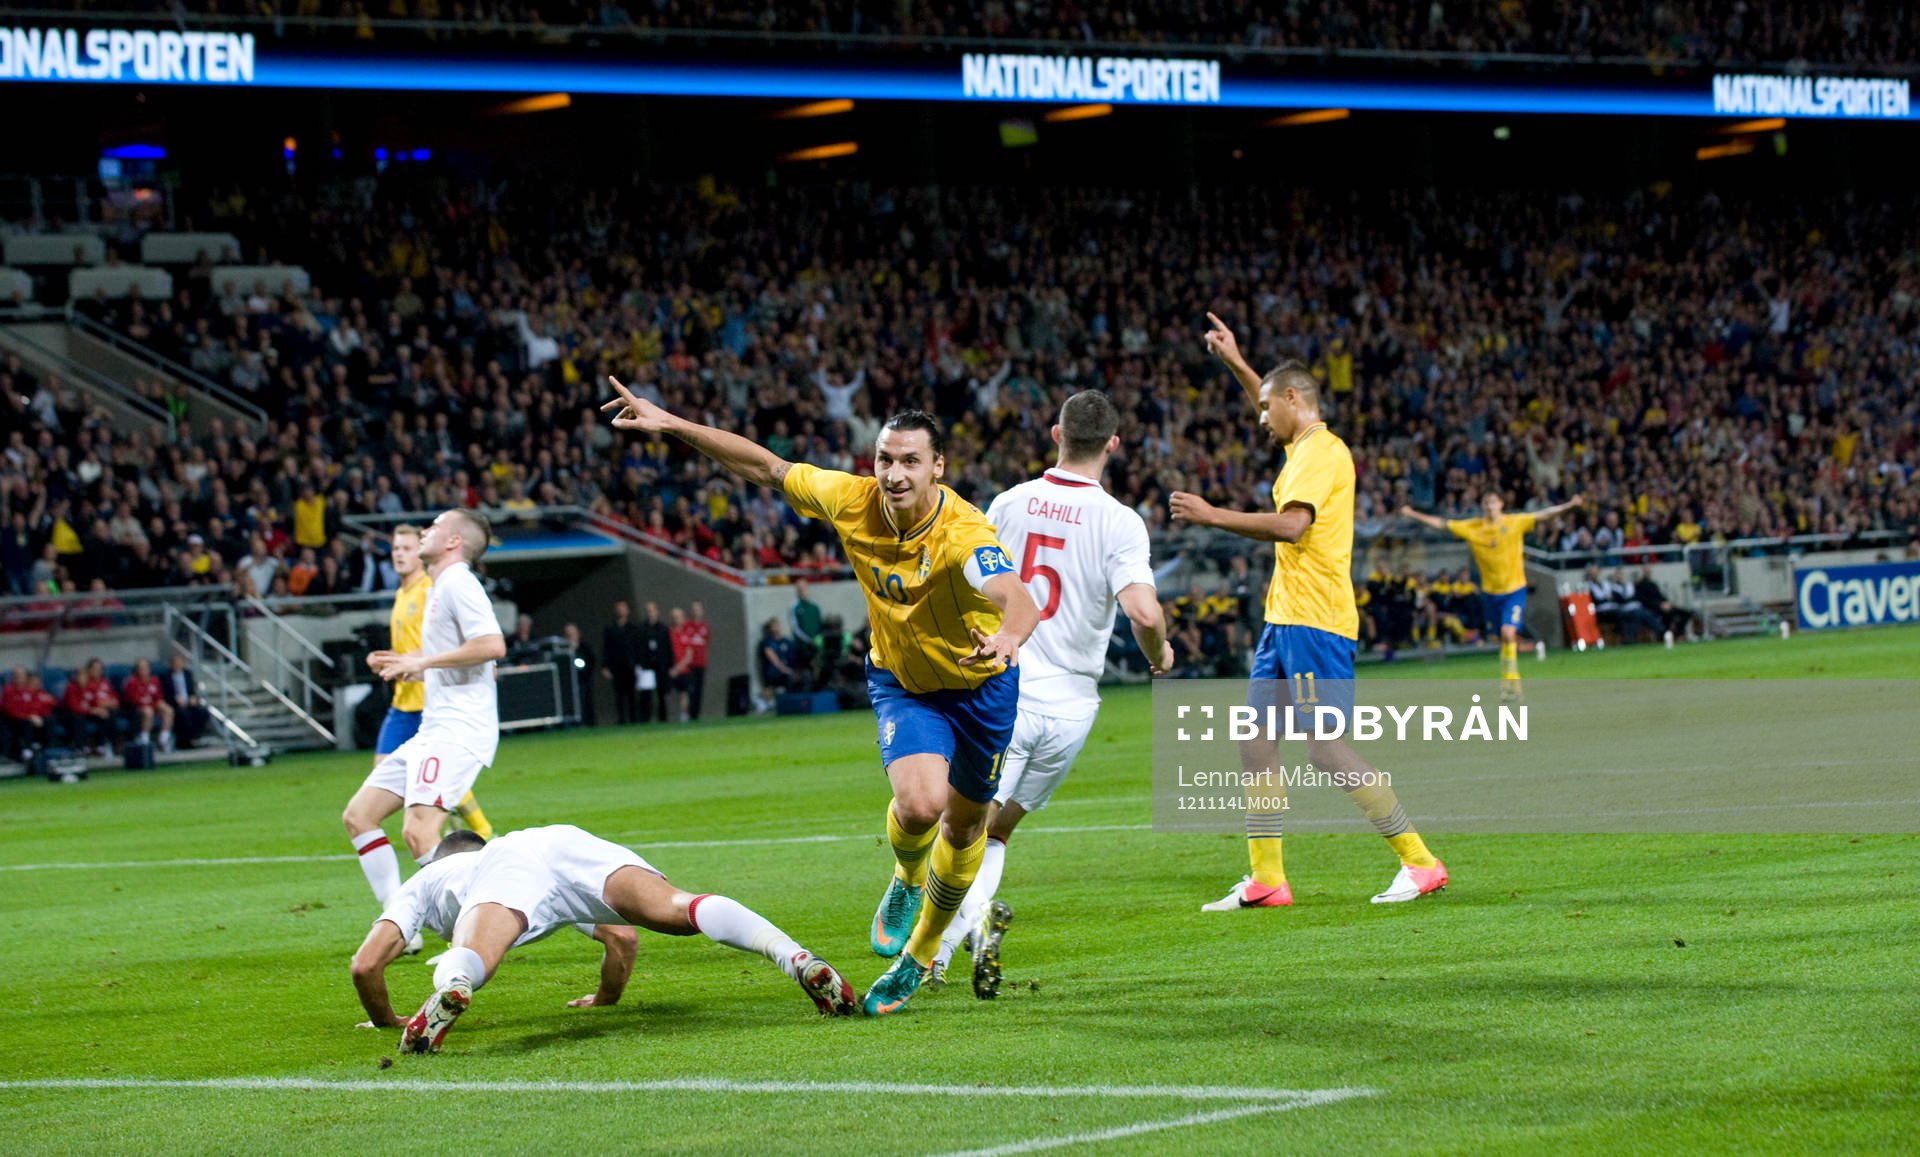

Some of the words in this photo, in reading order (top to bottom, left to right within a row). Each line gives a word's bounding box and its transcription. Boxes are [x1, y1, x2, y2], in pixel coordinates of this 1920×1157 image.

[961, 53, 1221, 102] NATIONALSPORTEN
[1713, 73, 1910, 116] NATIONALSPORTEN
[1027, 496, 1082, 525] CAHILL
[871, 566, 908, 604] 10
[1019, 532, 1066, 621] 5
[989, 747, 1009, 781] 1
